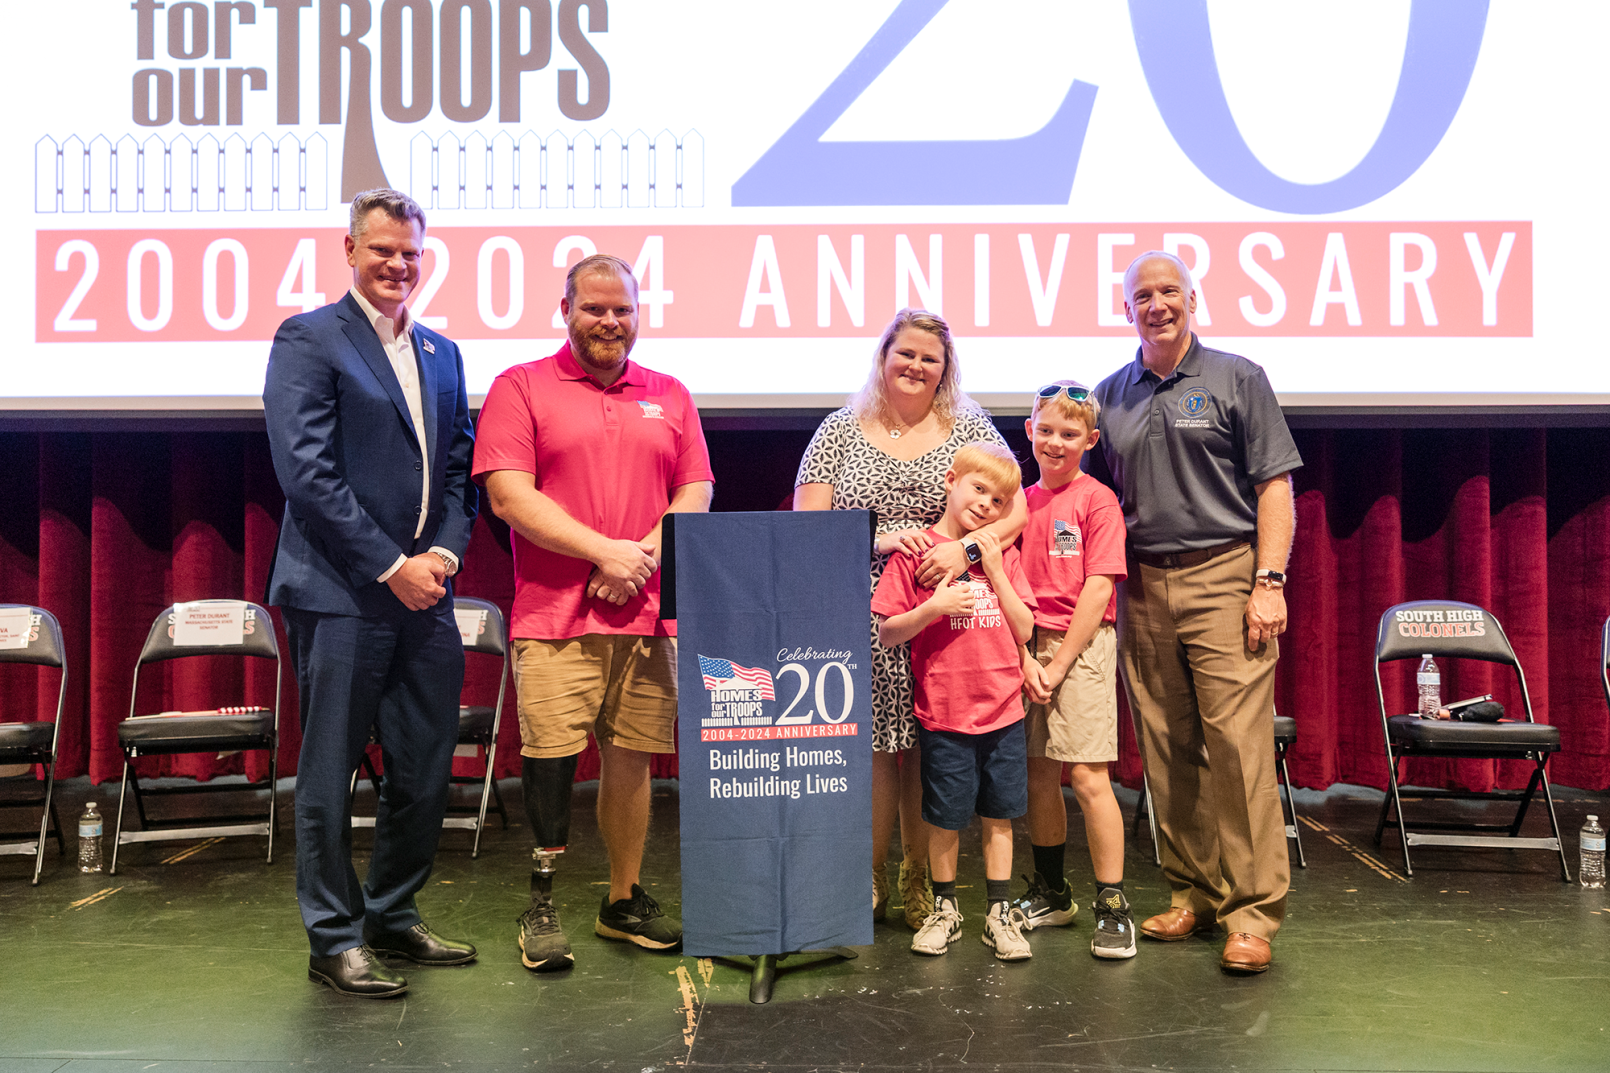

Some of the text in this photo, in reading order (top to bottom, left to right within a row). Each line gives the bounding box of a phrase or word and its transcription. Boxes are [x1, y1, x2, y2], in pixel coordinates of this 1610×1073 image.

[132, 67, 268, 127] our
[263, 0, 611, 203] TROOPS
[950, 615, 1002, 630] HFOT KIDS
[1395, 610, 1484, 622] SOUTH HIGH
[1398, 622, 1486, 637] COLONELS
[776, 646, 853, 665] Celebrating
[710, 688, 763, 703] HOMES
[711, 702, 725, 711] for
[711, 710, 727, 718] our
[725, 701, 763, 726] TROOPS
[702, 724, 857, 741] 2004-2024 ANNIVERSARY
[709, 746, 848, 772] Building Homes,
[709, 773, 848, 800] Rebuilding Lives
